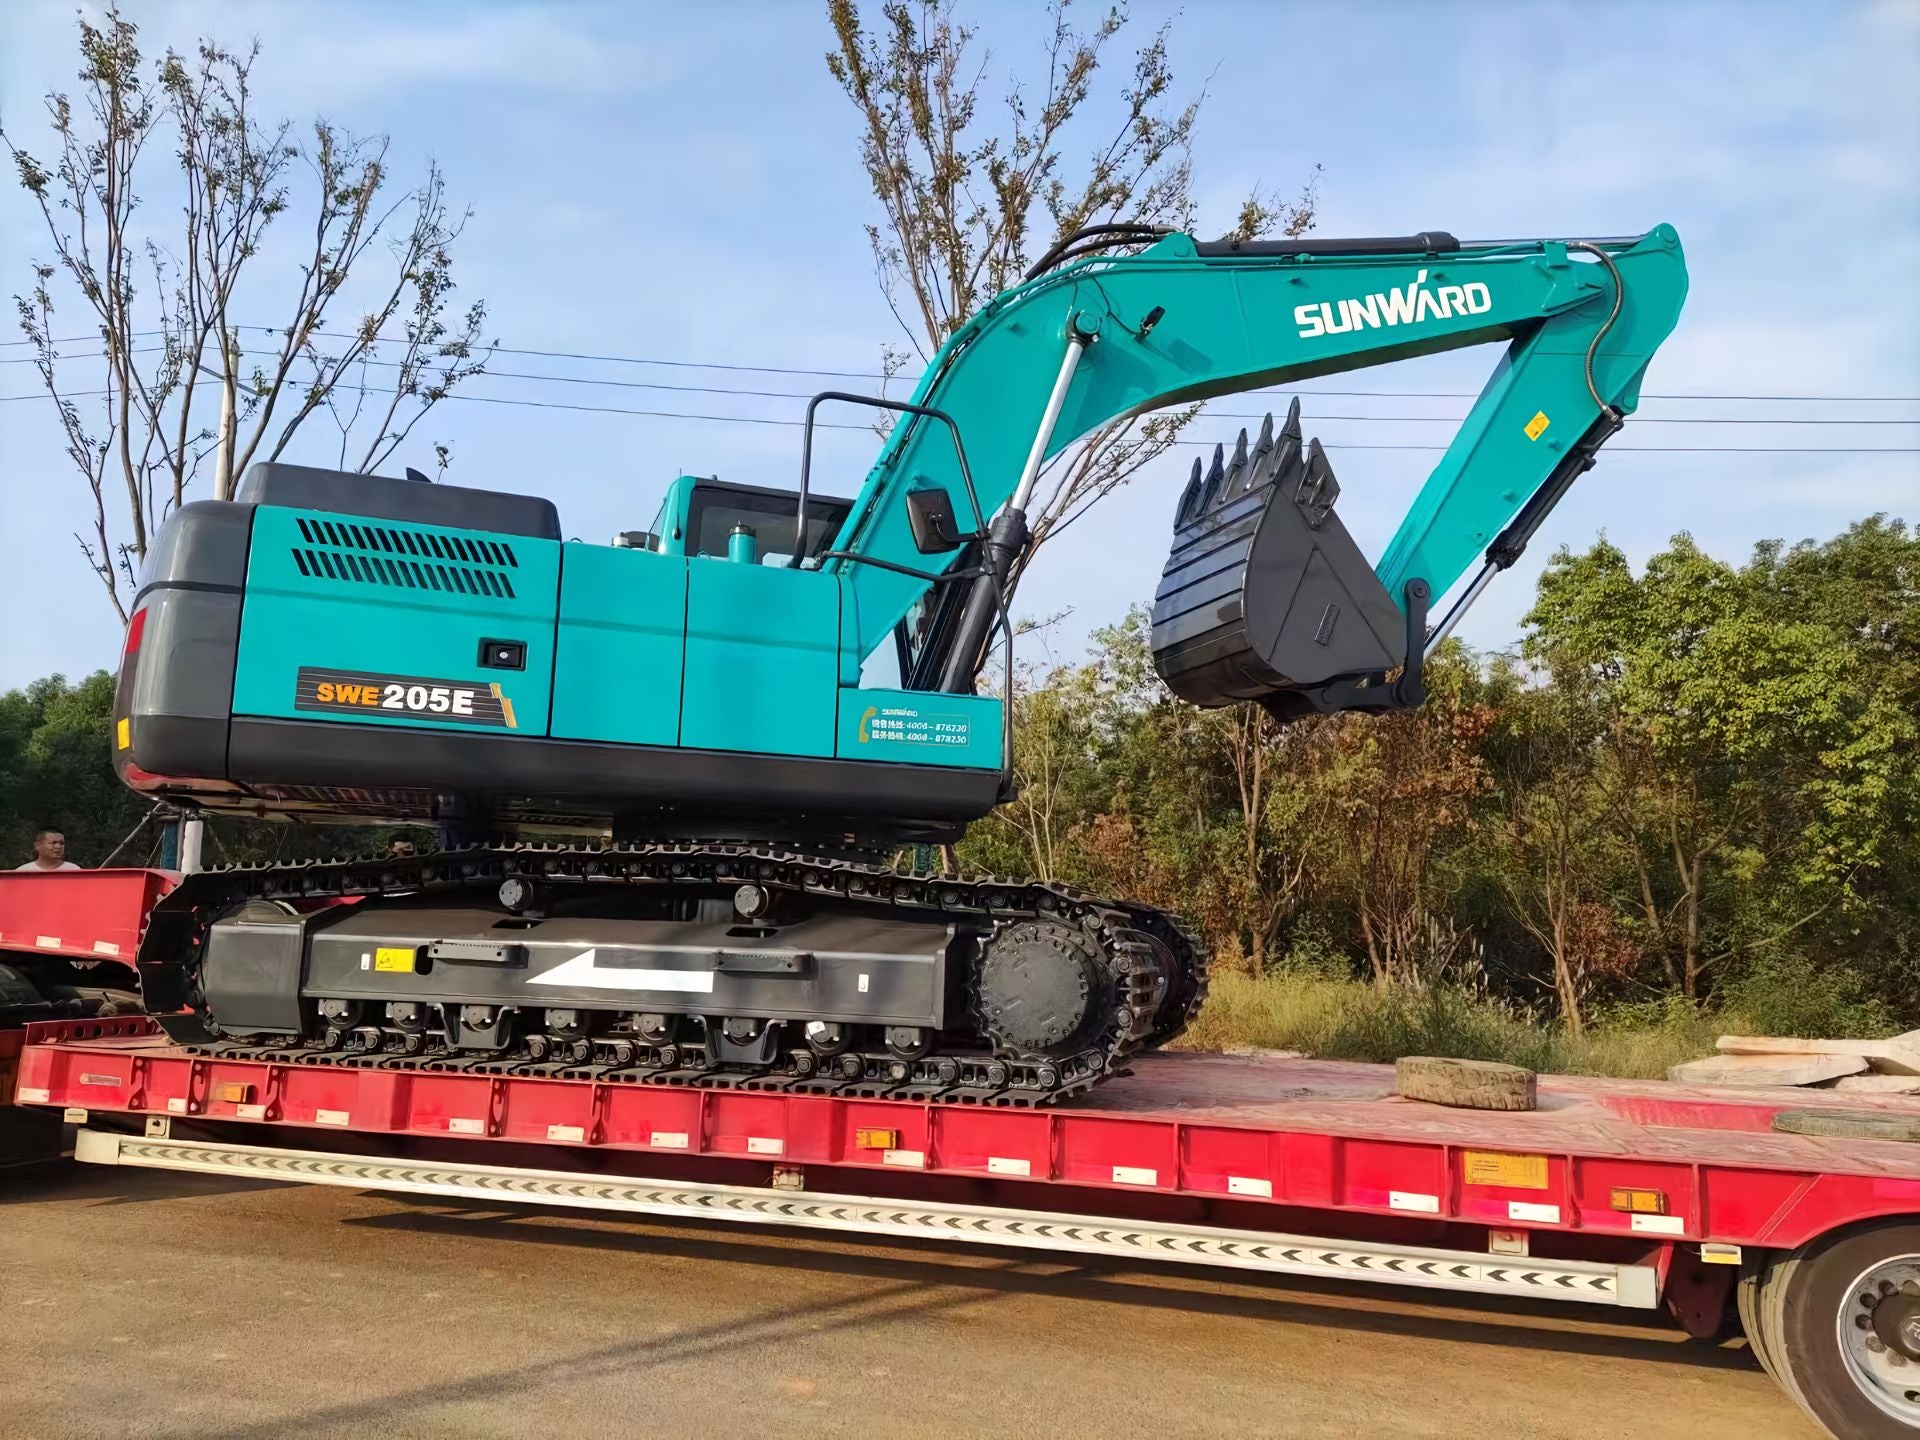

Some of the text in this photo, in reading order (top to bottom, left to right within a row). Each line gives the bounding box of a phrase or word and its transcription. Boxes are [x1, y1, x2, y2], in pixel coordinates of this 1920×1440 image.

[1294, 269, 1492, 338] SUNWARD
[316, 683, 475, 715] SWE 205E
